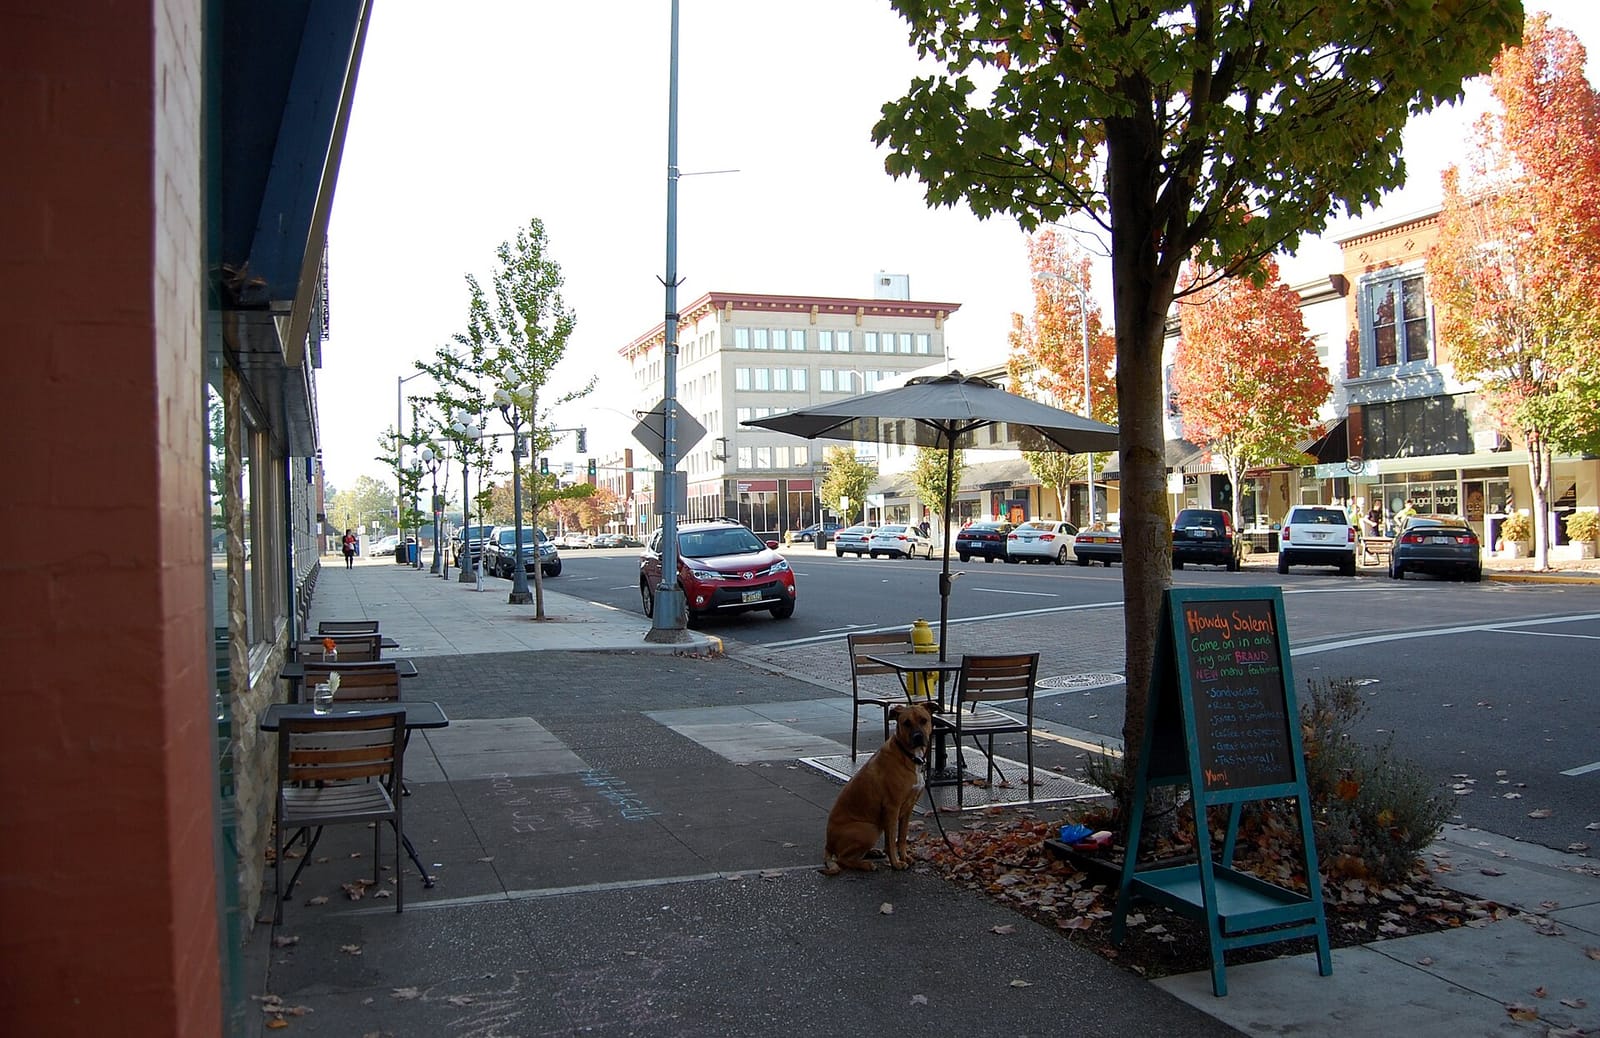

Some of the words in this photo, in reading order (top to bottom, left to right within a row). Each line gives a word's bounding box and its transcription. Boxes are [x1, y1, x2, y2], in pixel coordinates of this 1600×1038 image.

[1186, 609, 1231, 639] Howdy
[1232, 611, 1275, 635] Salem!
[1191, 637, 1219, 653] Come
[1222, 640, 1234, 649] on
[1238, 637, 1250, 647] in
[1254, 635, 1272, 646] and
[1197, 654, 1215, 669] try
[1235, 650, 1270, 663] BRAND
[1196, 670, 1218, 680] NEW
[1220, 667, 1244, 677] menu
[1205, 768, 1229, 786] Yum!
